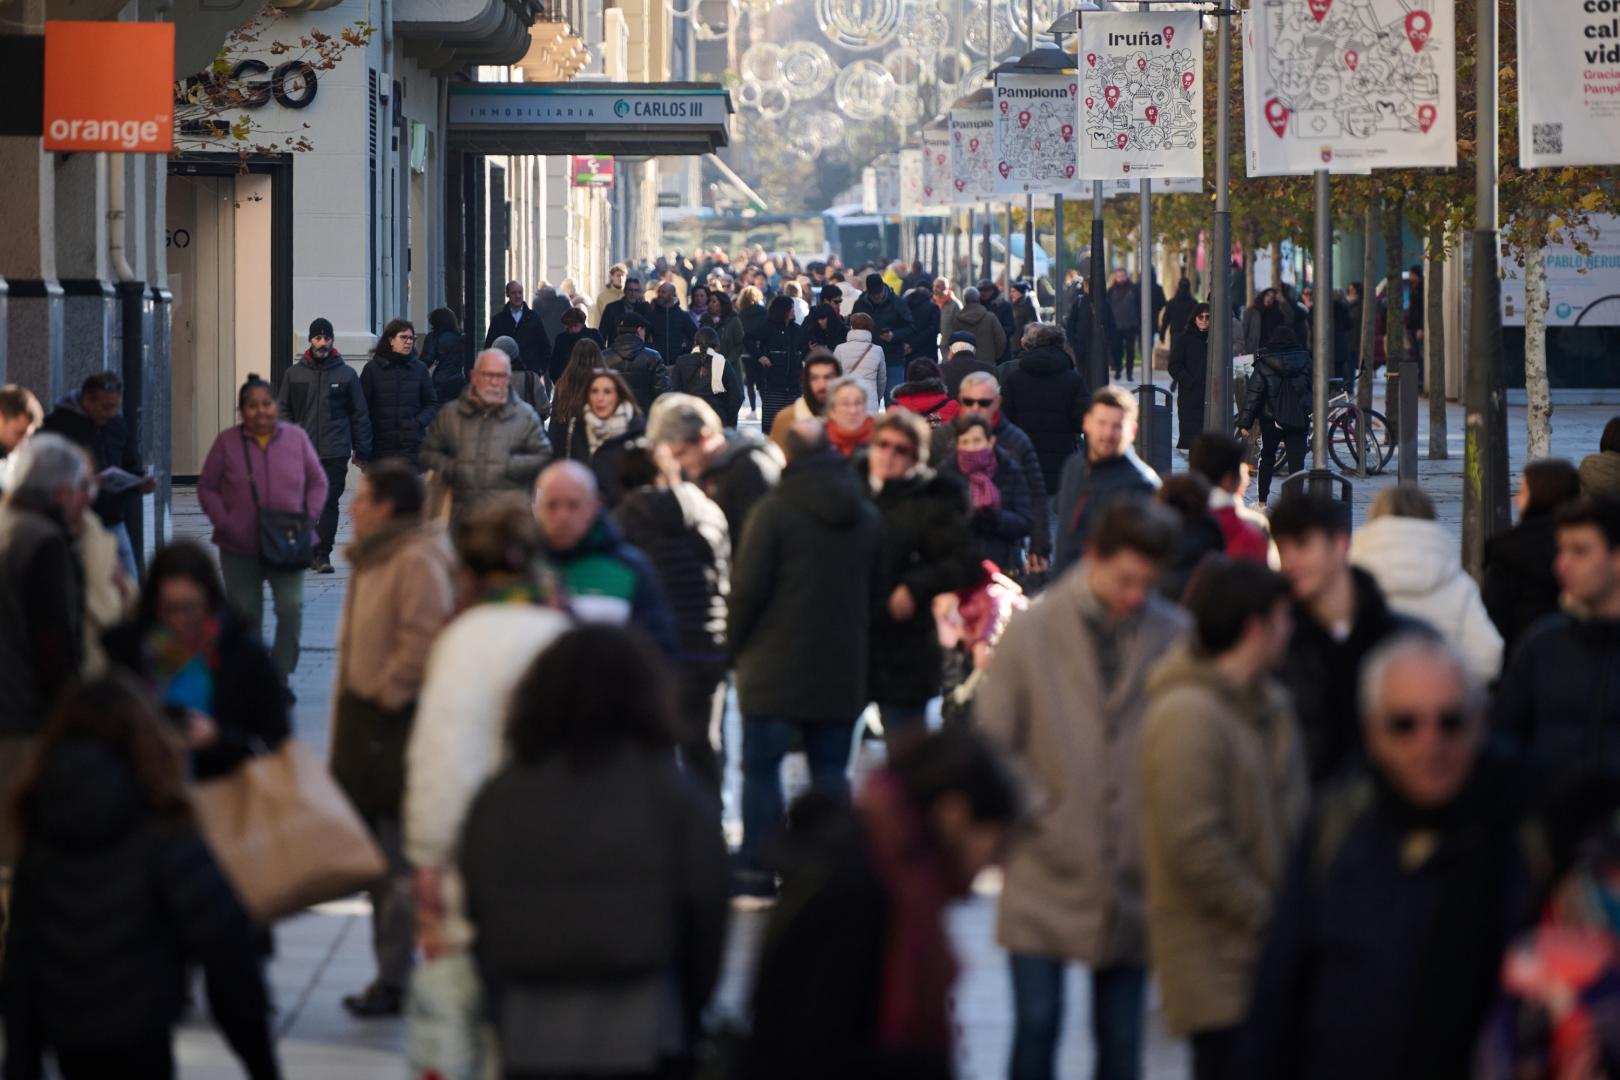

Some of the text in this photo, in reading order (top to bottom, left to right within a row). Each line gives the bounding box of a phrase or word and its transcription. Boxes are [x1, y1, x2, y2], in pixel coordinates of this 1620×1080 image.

[1584, 18, 1620, 38] cal
[1108, 31, 1162, 47] Iruña
[998, 87, 1068, 99] Pamplona
[470, 101, 703, 117] INMOBILIARIA CARLOS III
[50, 118, 159, 148] orange
[952, 120, 993, 130] Pamplo
[1546, 255, 1583, 268] PABLO
